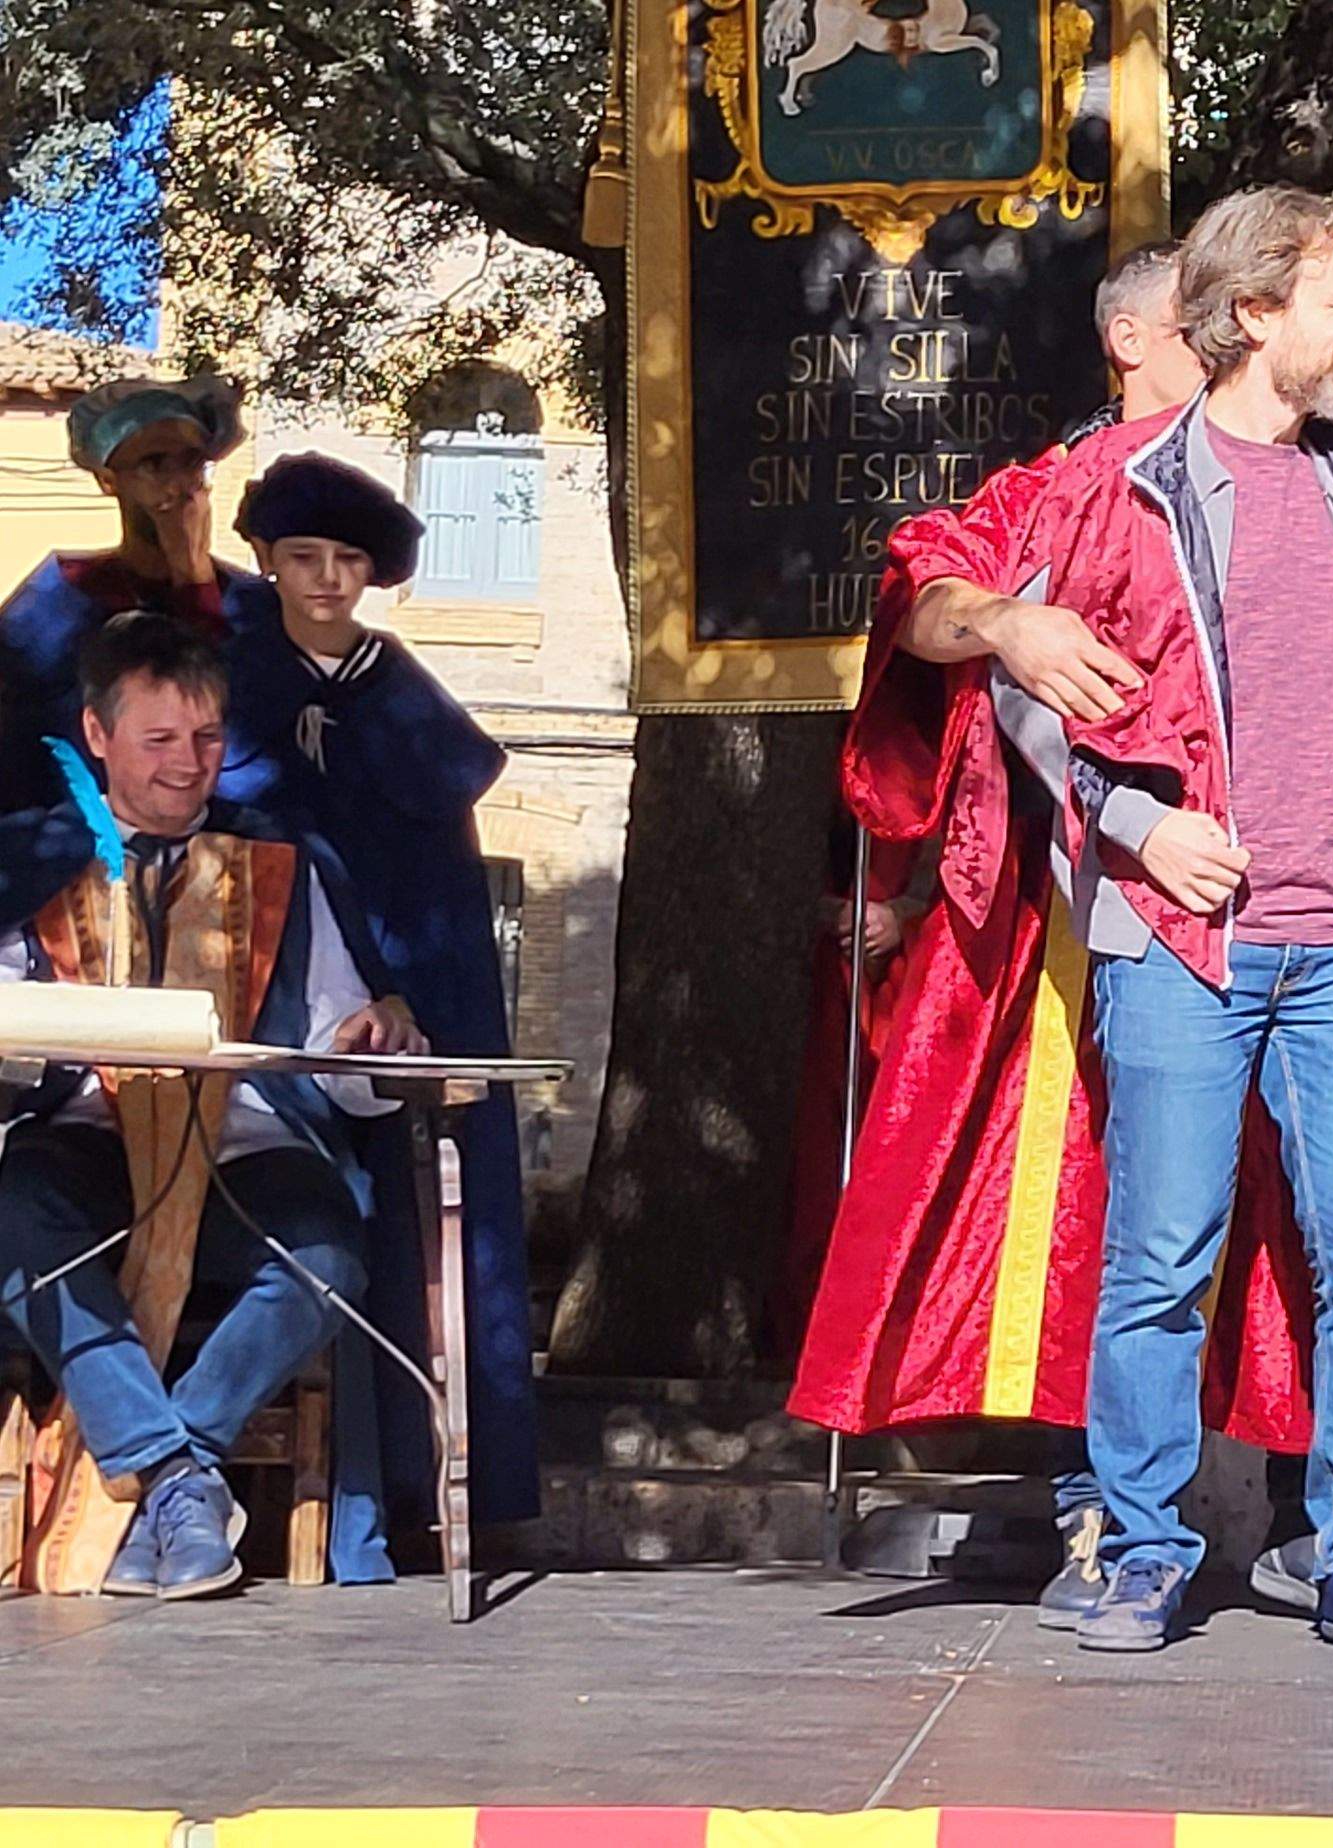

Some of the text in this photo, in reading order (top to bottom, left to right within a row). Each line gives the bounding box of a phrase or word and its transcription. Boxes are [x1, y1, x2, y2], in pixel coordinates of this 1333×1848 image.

[832, 268, 963, 321] VIVE
[789, 330, 1017, 385] SIN SILLA
[756, 390, 1052, 444] SIN ESTRIBOS
[750, 452, 1017, 508] SIN ESPUEL
